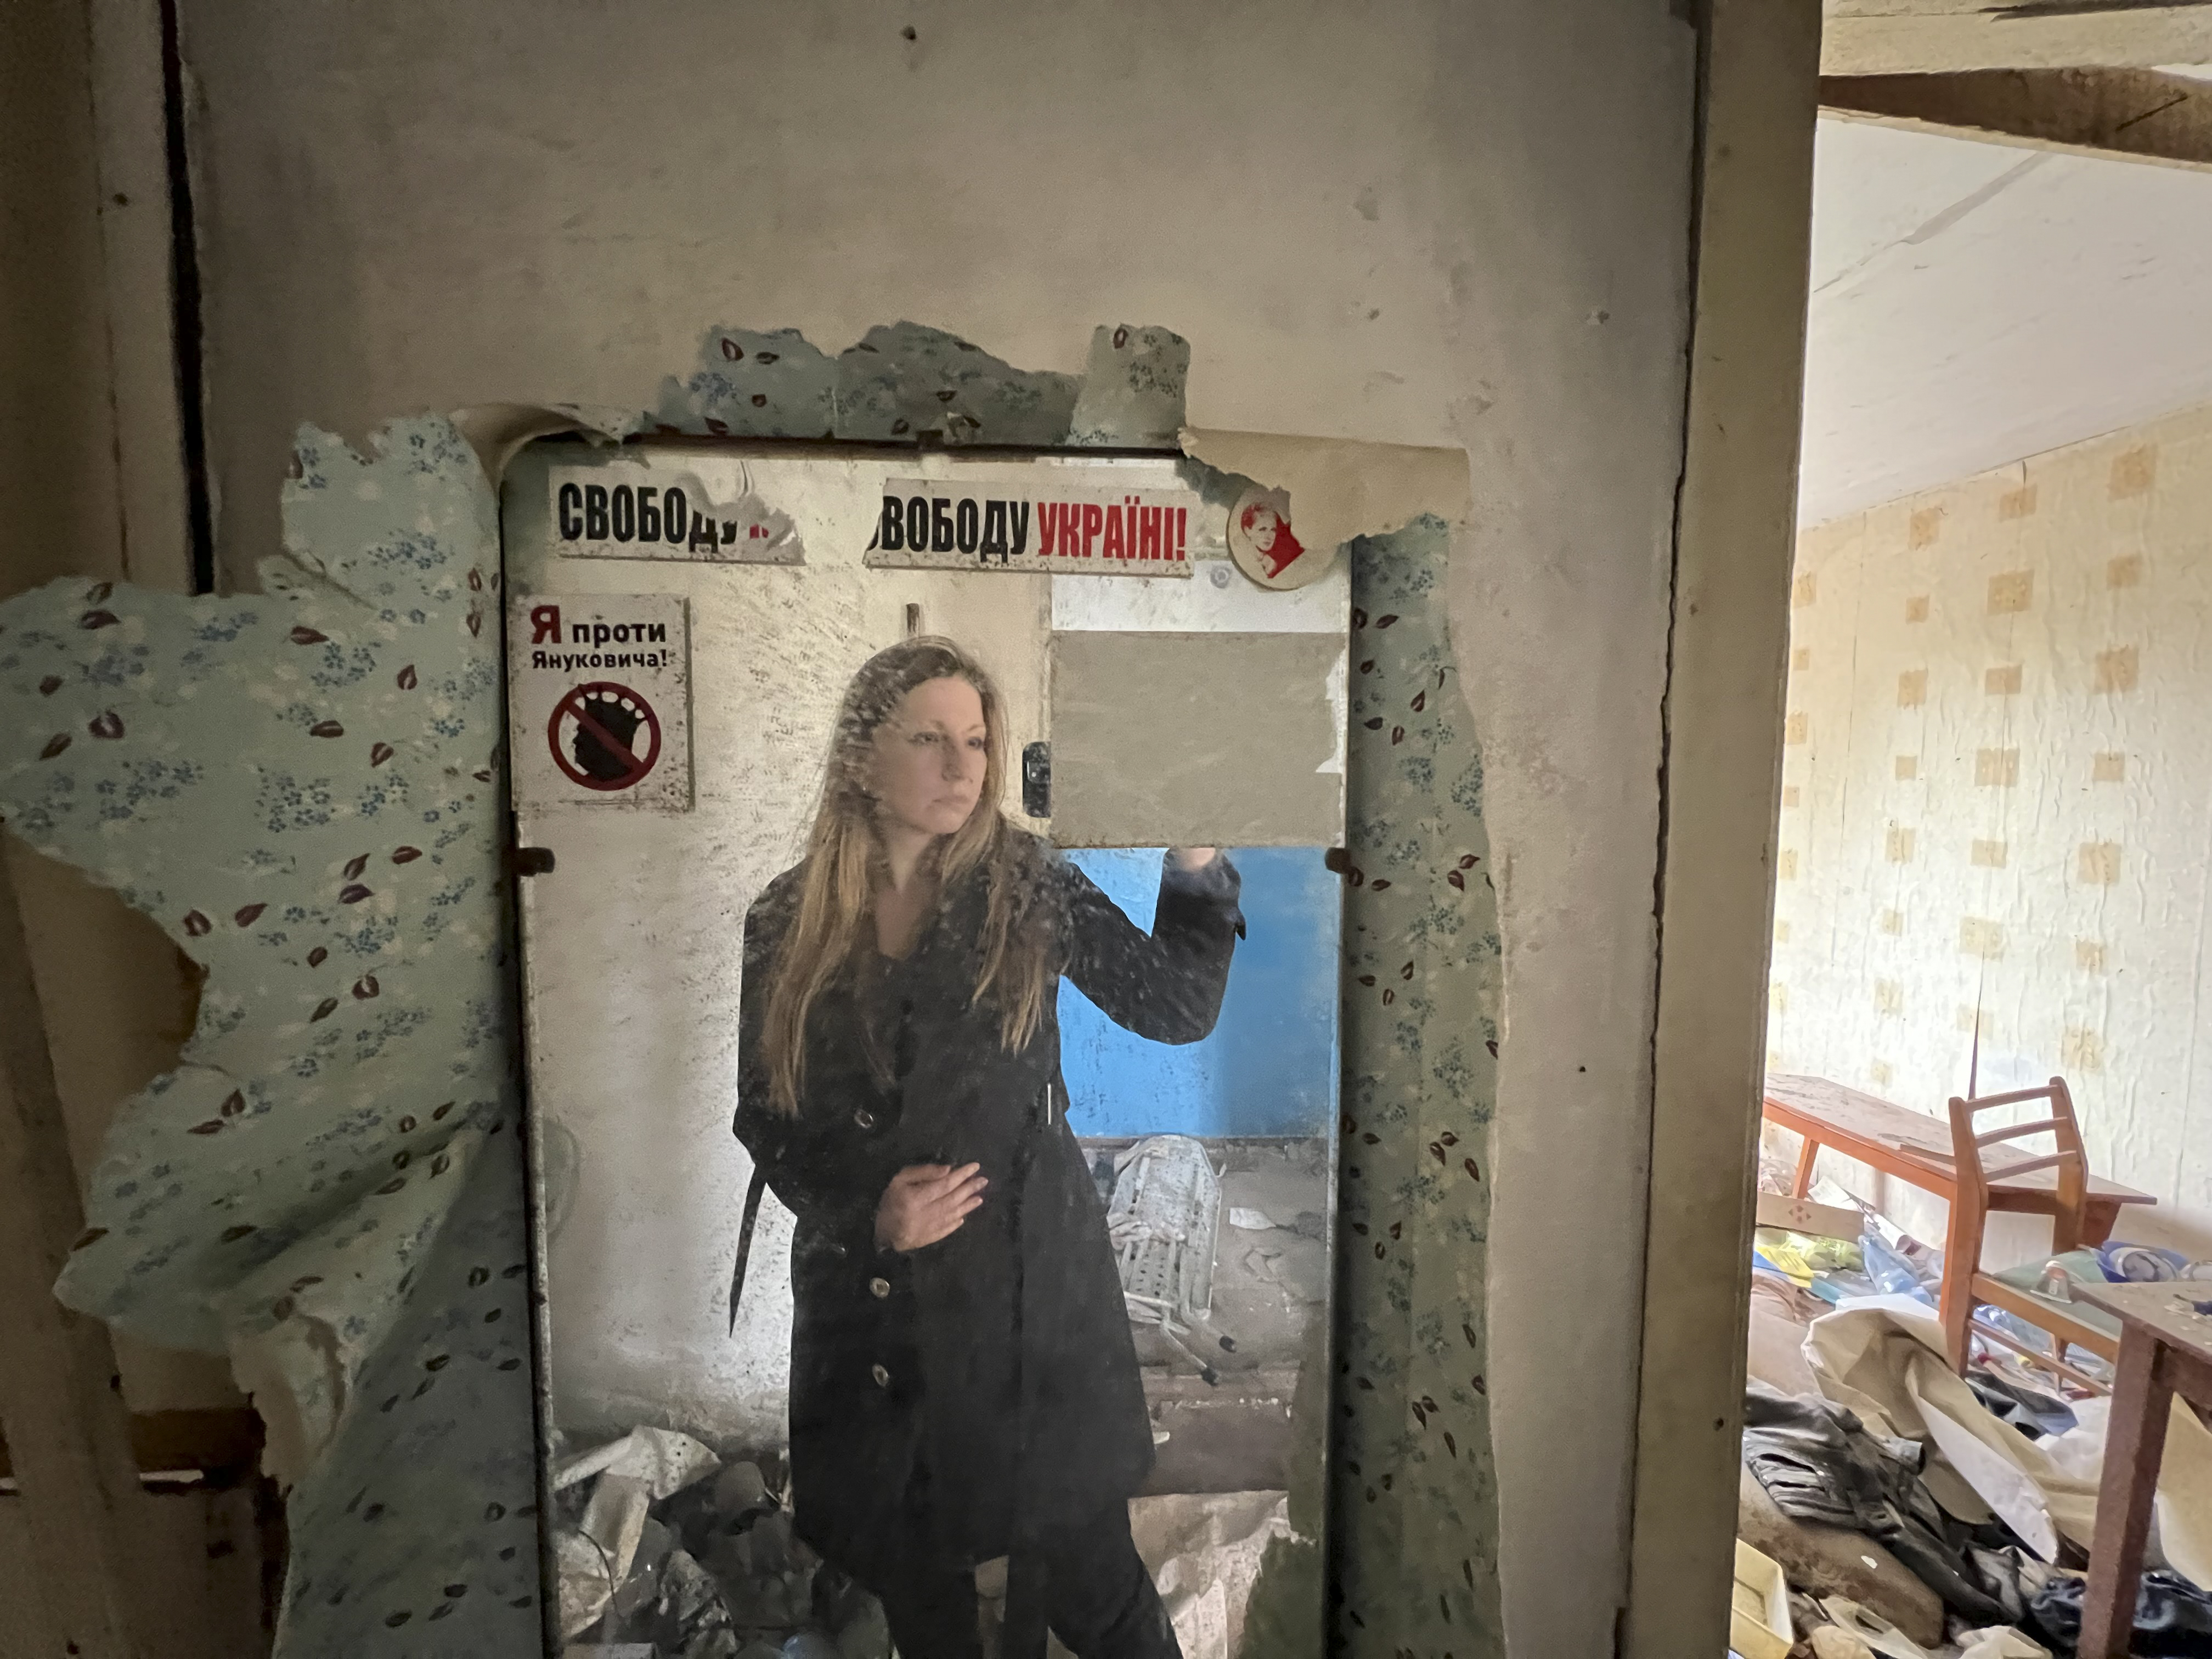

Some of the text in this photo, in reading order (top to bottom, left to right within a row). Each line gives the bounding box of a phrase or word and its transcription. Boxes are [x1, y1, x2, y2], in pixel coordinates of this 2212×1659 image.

[866, 495, 1187, 563] ВОБОДУ УКРАЇНІ!
[530, 605, 667, 649] Я проти
[532, 649, 667, 673] Януковича!
